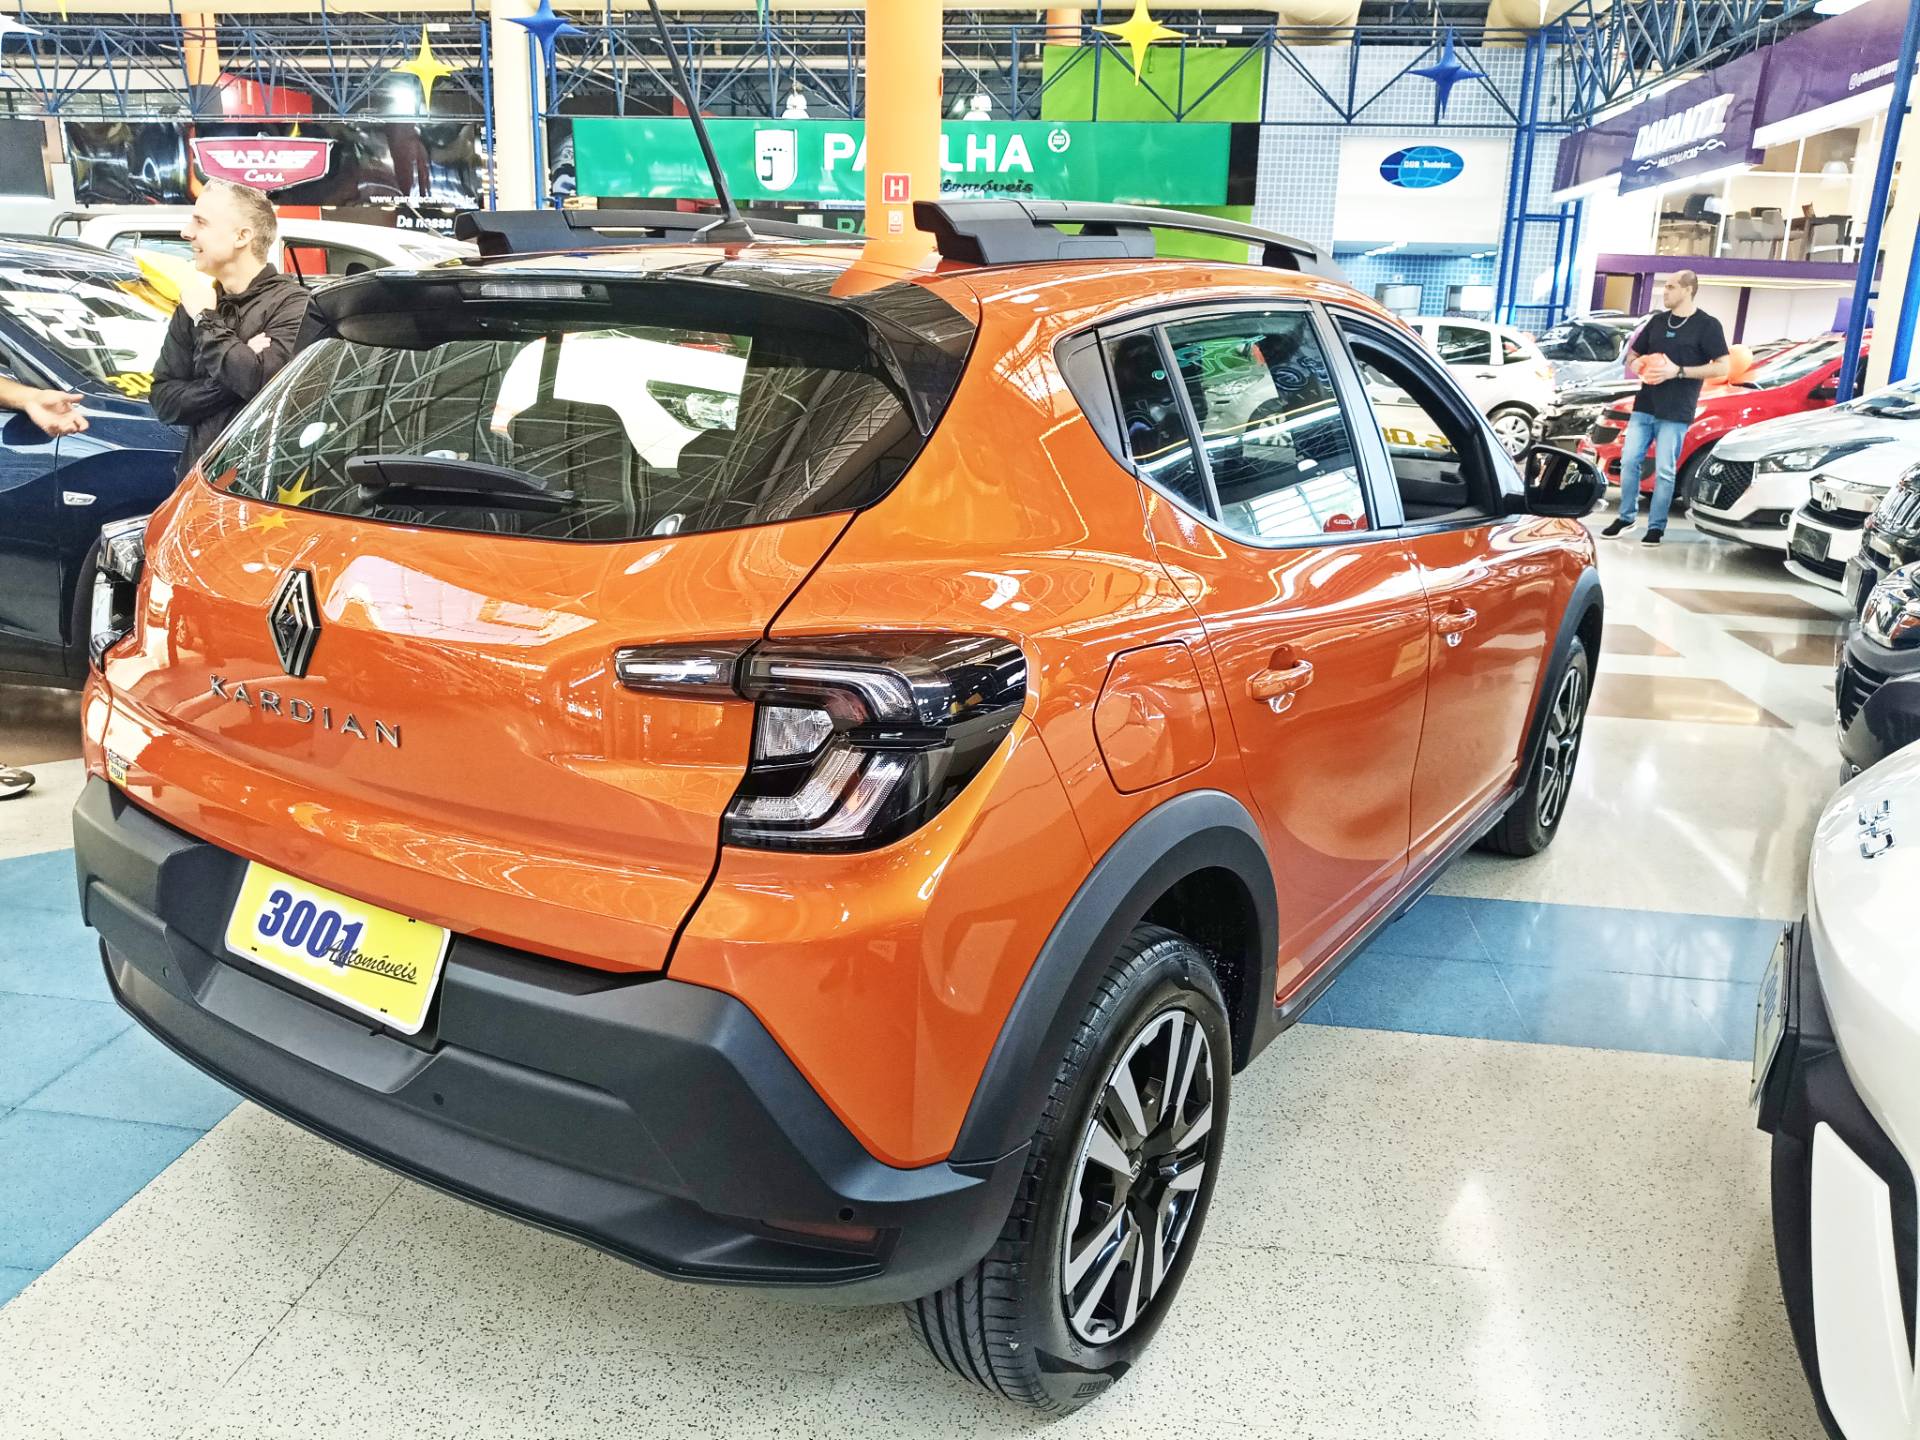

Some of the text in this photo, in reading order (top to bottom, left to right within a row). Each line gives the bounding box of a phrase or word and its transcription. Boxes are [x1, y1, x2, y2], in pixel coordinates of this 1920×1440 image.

[244, 169, 285, 182] Cars
[889, 178, 904, 198] H
[396, 214, 453, 229] Da nossa
[208, 672, 402, 750] KARDIAN
[258, 889, 363, 969] 3001
[319, 938, 418, 983] Automóveis
